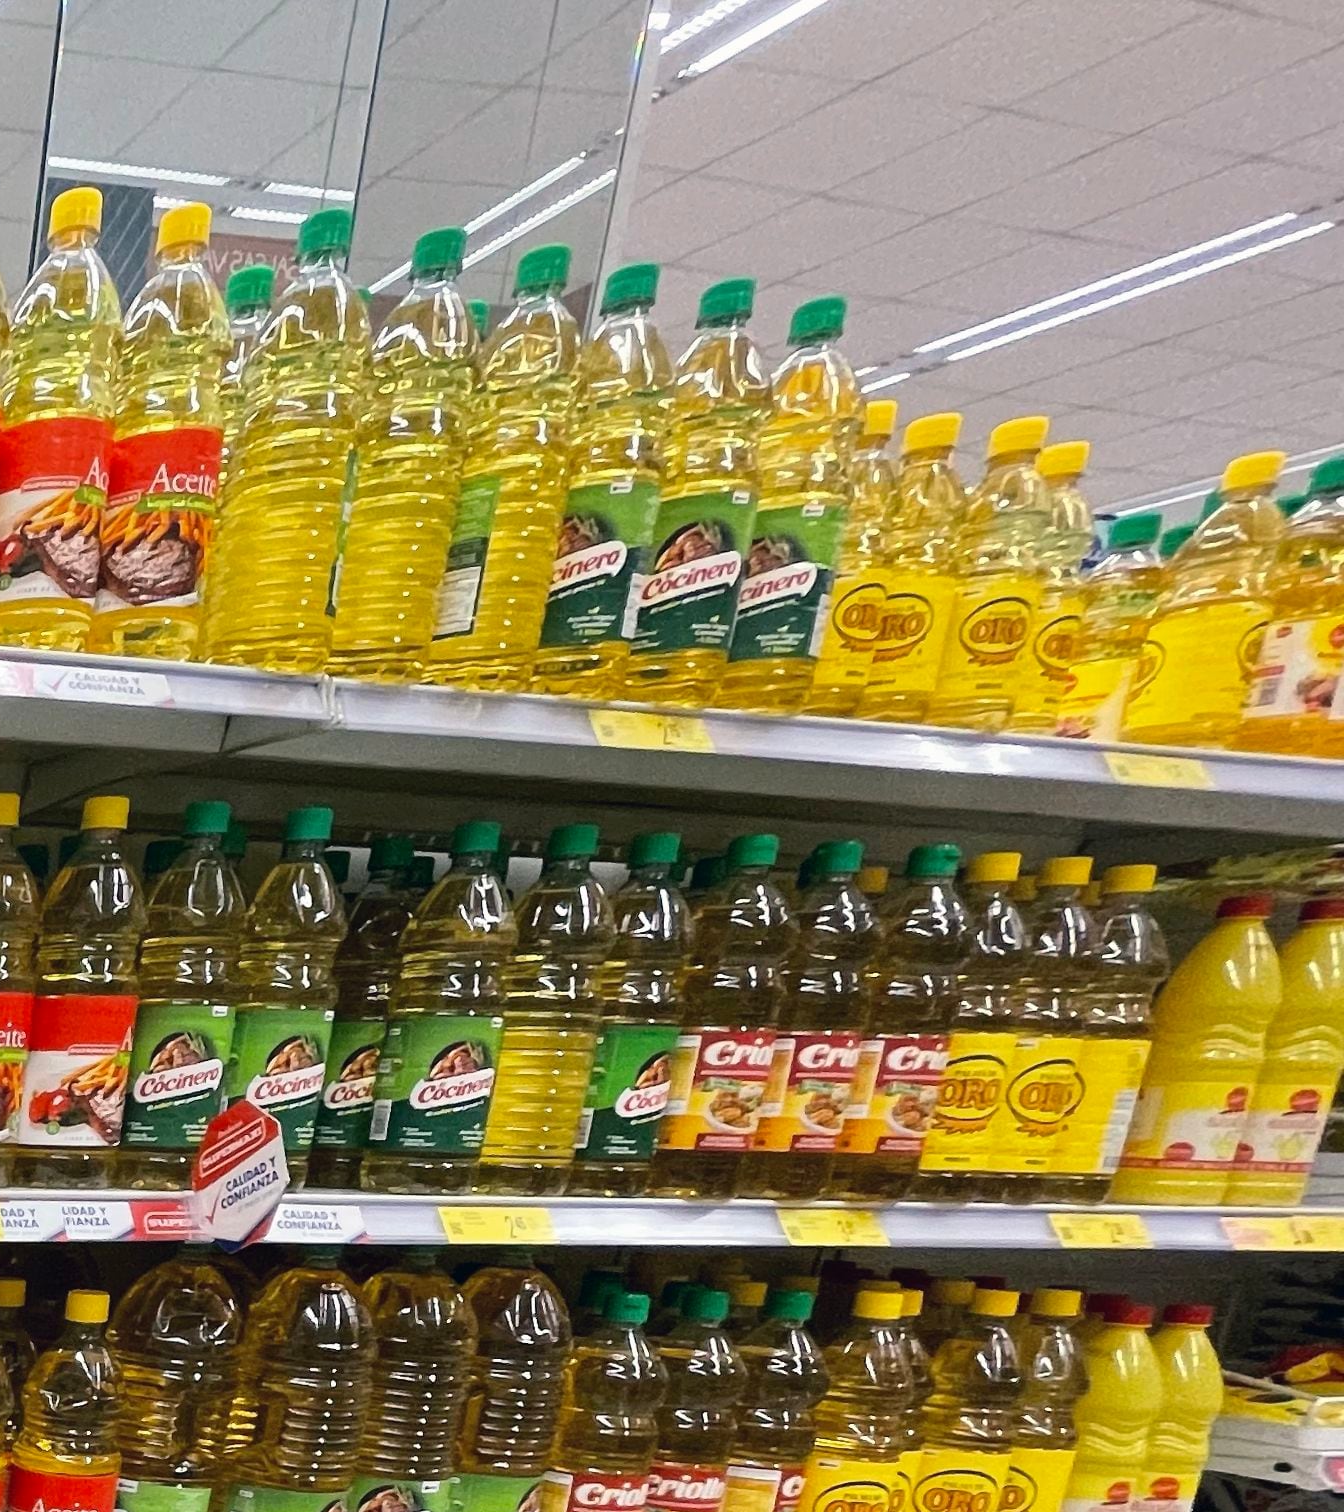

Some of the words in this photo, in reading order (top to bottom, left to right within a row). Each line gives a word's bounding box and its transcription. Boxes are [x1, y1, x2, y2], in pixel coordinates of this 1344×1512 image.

[641, 559, 738, 601] Cocinero
[139, 1067, 220, 1097] Cocinero
[221, 1170, 279, 1209] CONFIANZA
[225, 1162, 267, 1192] CALIDAD
[269, 1157, 277, 1169] Y
[276, 1220, 342, 1230] CONFIANZA
[282, 1210, 328, 1220] CALIDAD
[331, 1211, 338, 1220] Y
